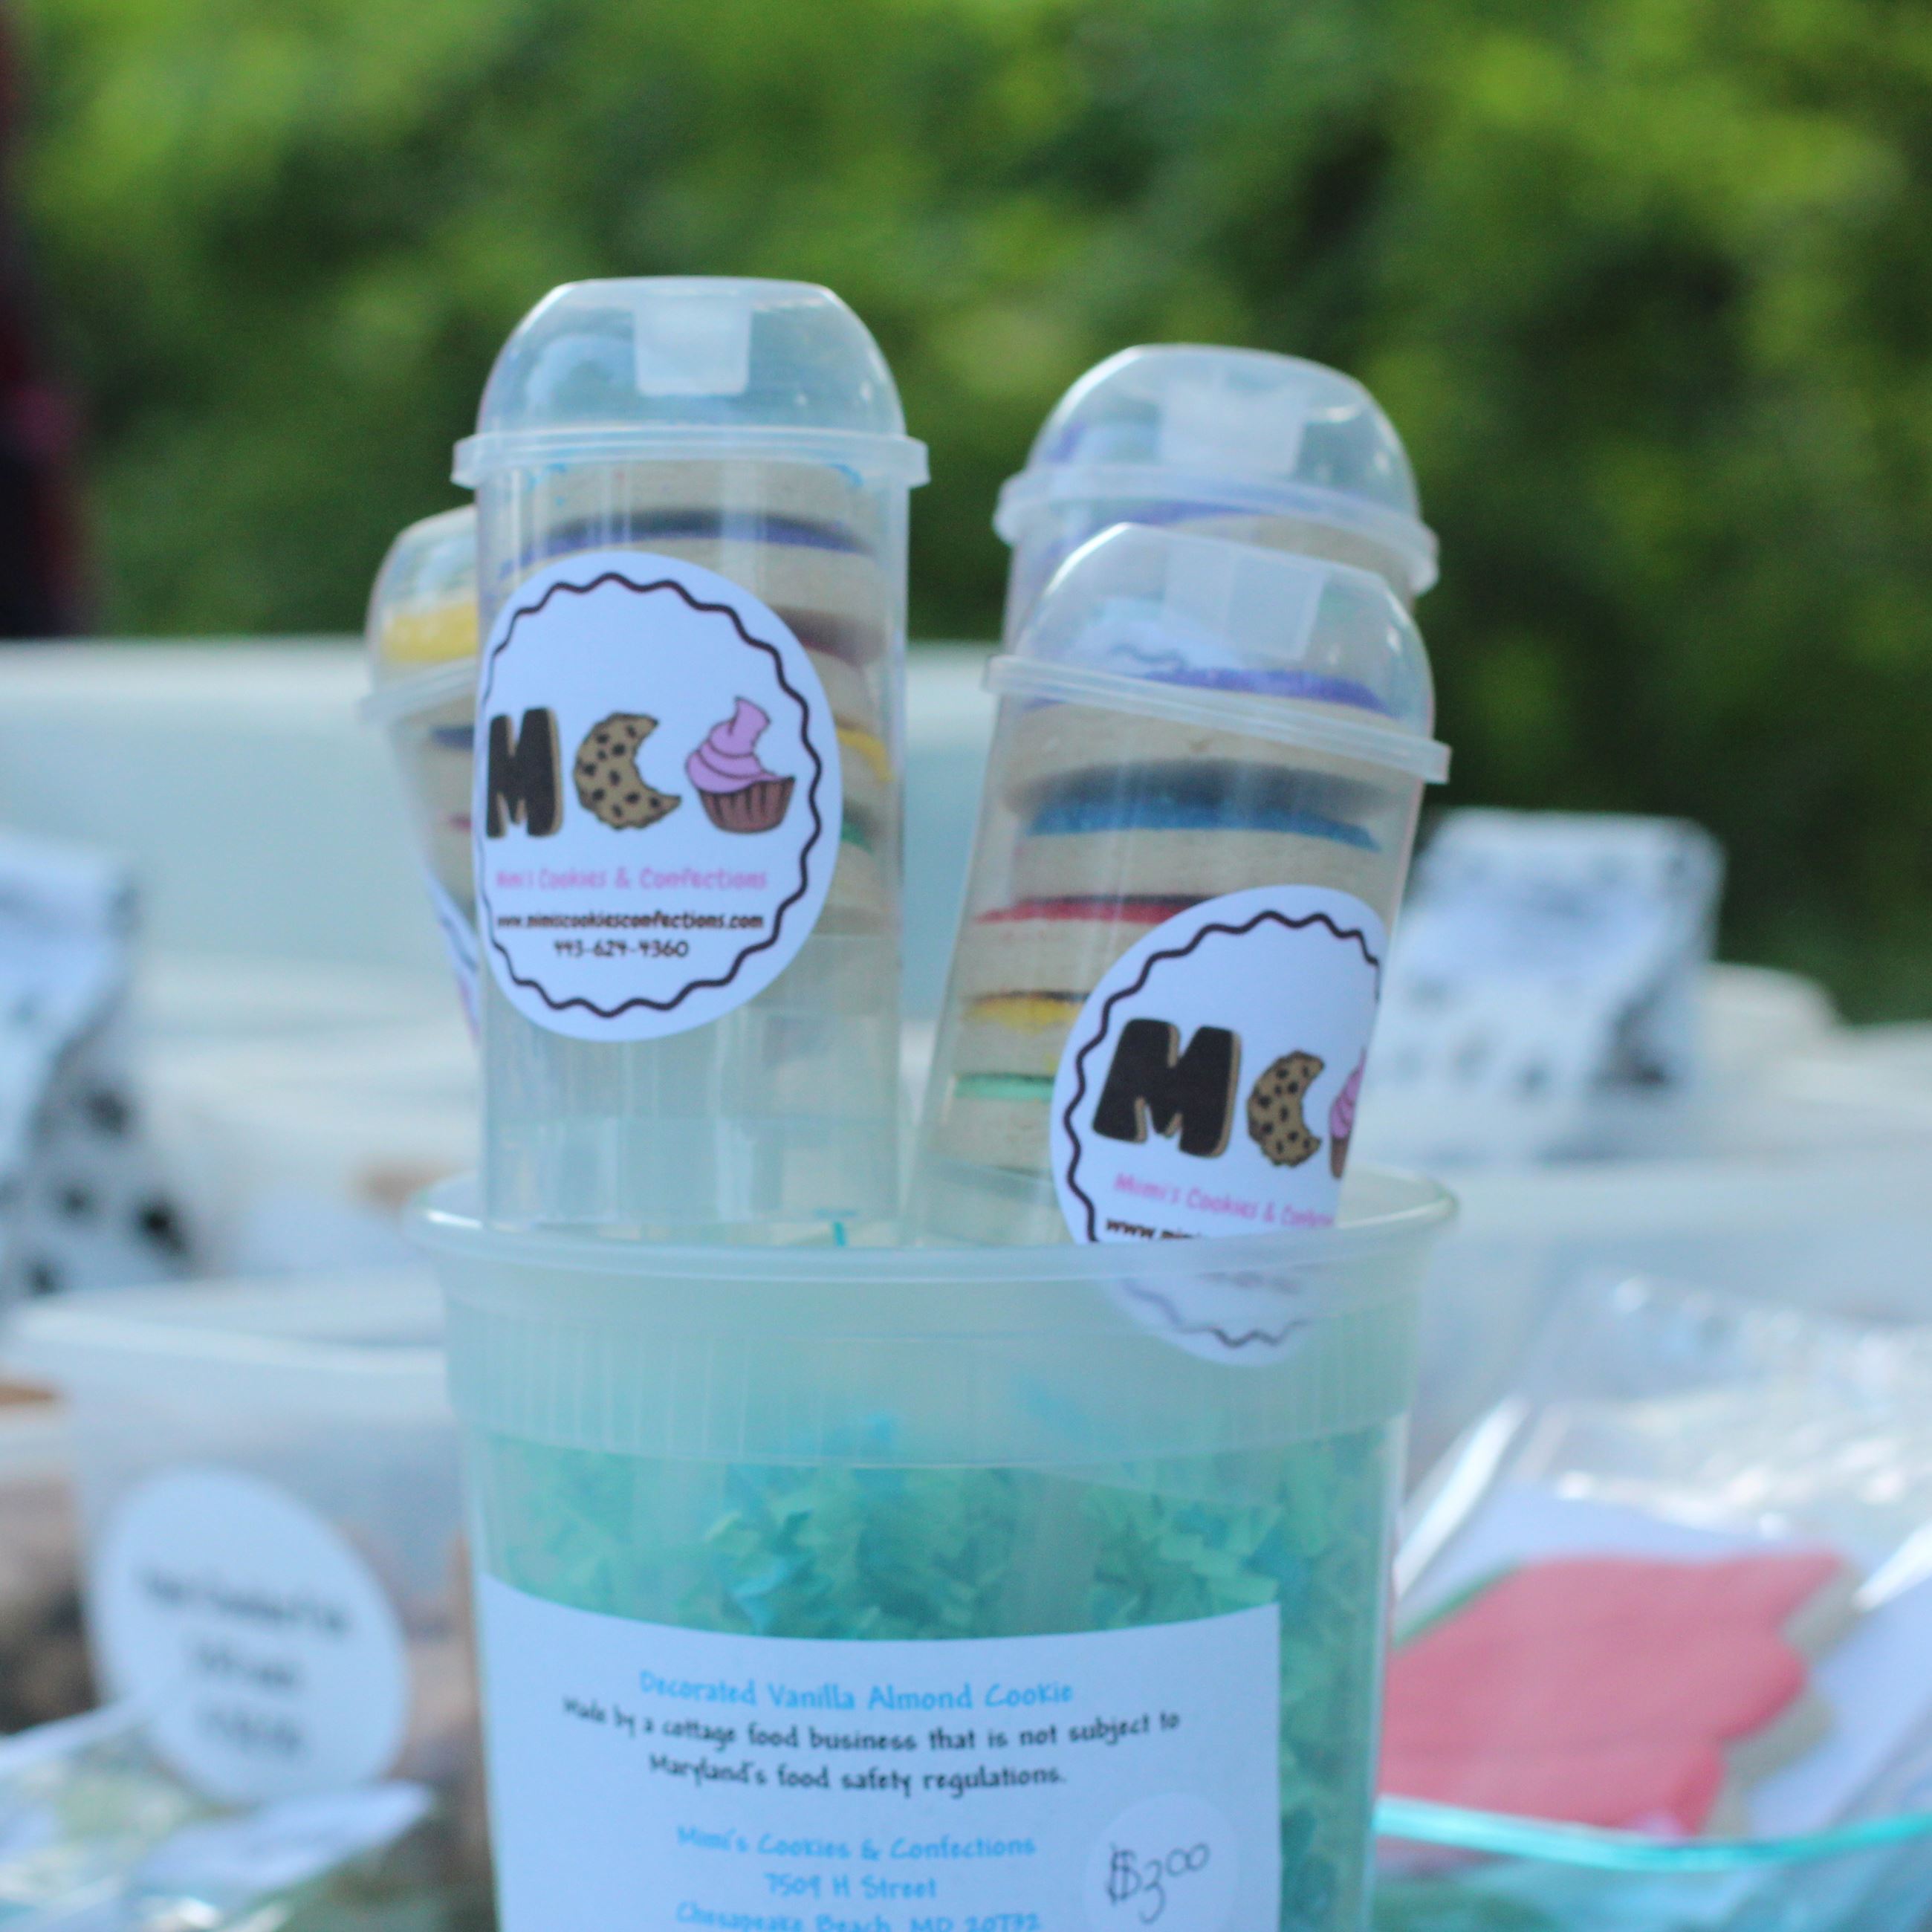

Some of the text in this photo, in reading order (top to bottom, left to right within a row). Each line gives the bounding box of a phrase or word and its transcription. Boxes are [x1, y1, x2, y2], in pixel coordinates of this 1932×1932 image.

[539, 868, 606, 890] Cookies
[615, 866, 630, 889] &
[640, 867, 768, 889] Confections
[1115, 1172, 1180, 1205] Mimi's
[1187, 1187, 1258, 1219] Cookies
[1264, 1202, 1275, 1223] &
[639, 1670, 1074, 1711] Decorated Vanilla Almond Cookie
[563, 1696, 1180, 1752] Made by a cottage food business that is not subject to
[649, 1752, 1068, 1798] Maryland's food safety regulations.
[677, 1826, 1036, 1861] Mimi's Cookies & Confections
[832, 1874, 850, 1898] H
[860, 1875, 938, 1900] Street
[676, 1902, 804, 1932] Chesapeake
